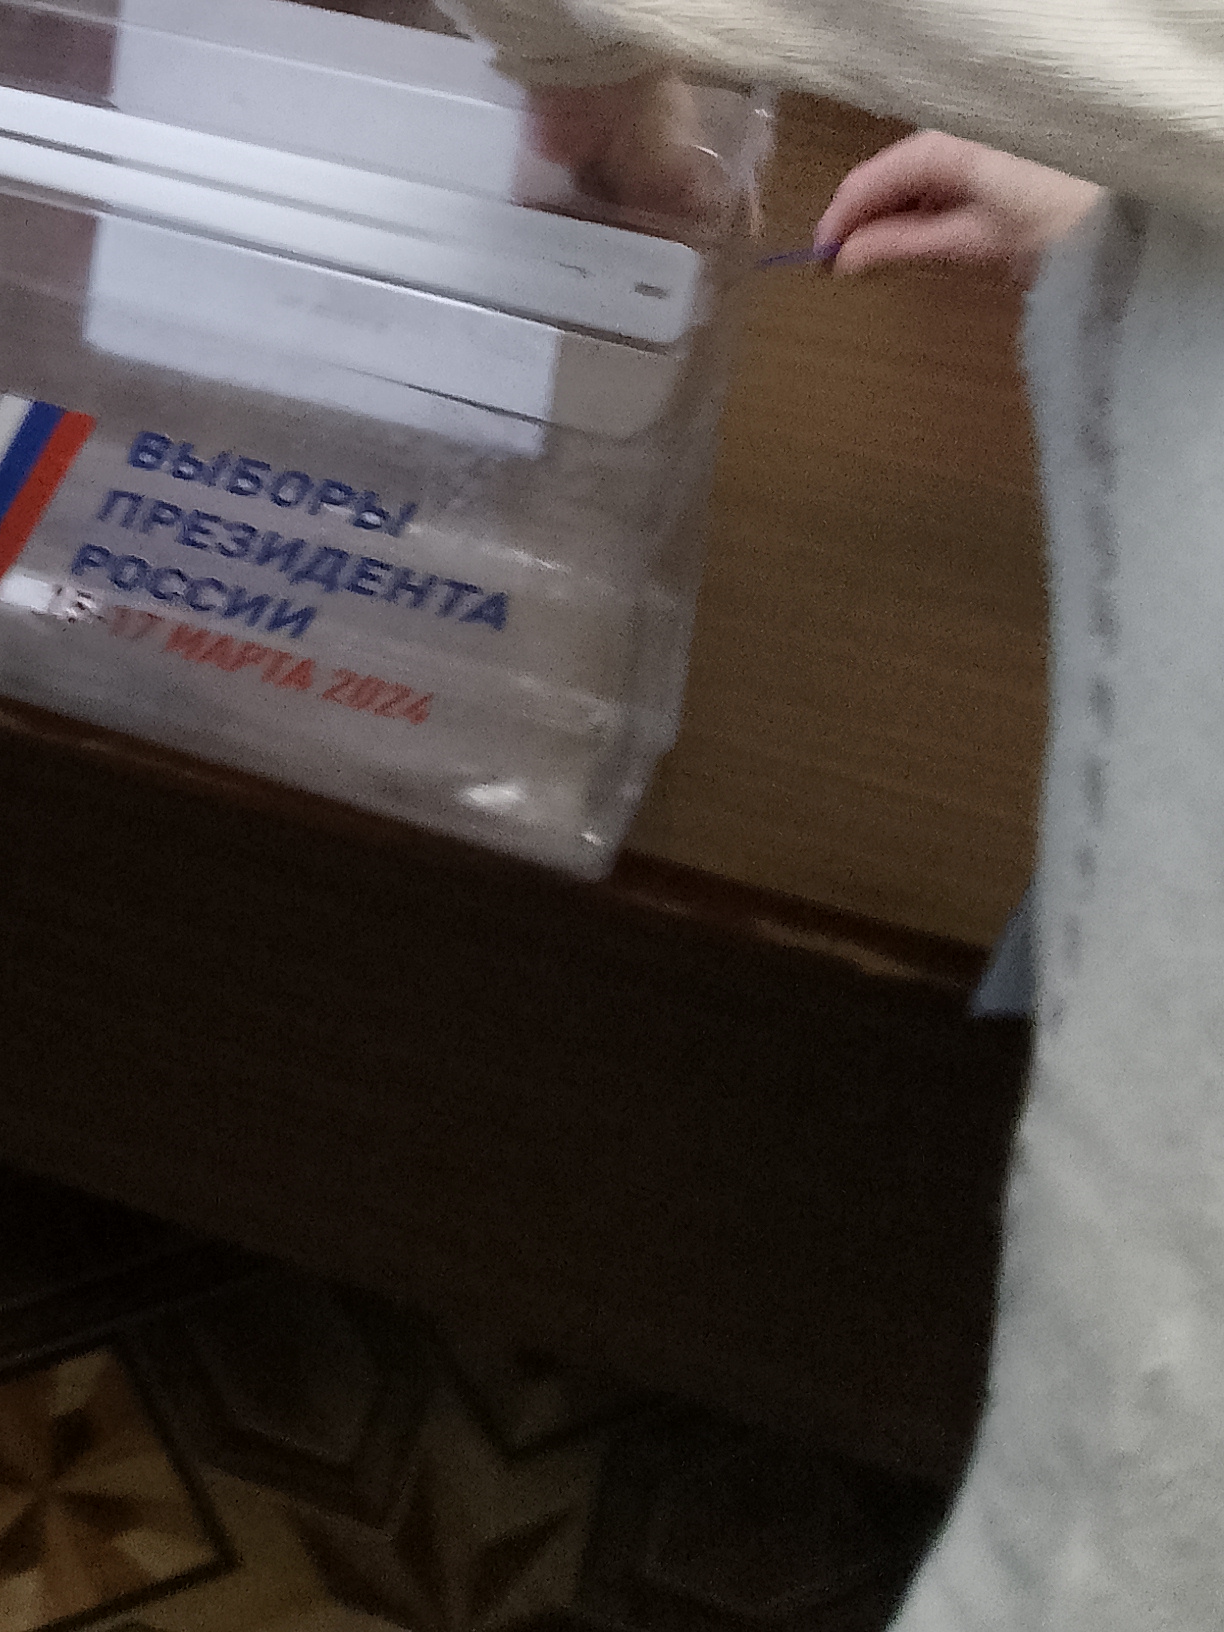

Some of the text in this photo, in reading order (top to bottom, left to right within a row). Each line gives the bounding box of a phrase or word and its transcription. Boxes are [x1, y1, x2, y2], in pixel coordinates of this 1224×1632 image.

[128, 432, 417, 536] ВЫБОРЫ
[72, 543, 317, 638] РОССИИ
[97, 489, 509, 631] ПРЕЗИДЕНТА
[166, 624, 316, 691] МАРТА
[322, 669, 433, 725] 2024
